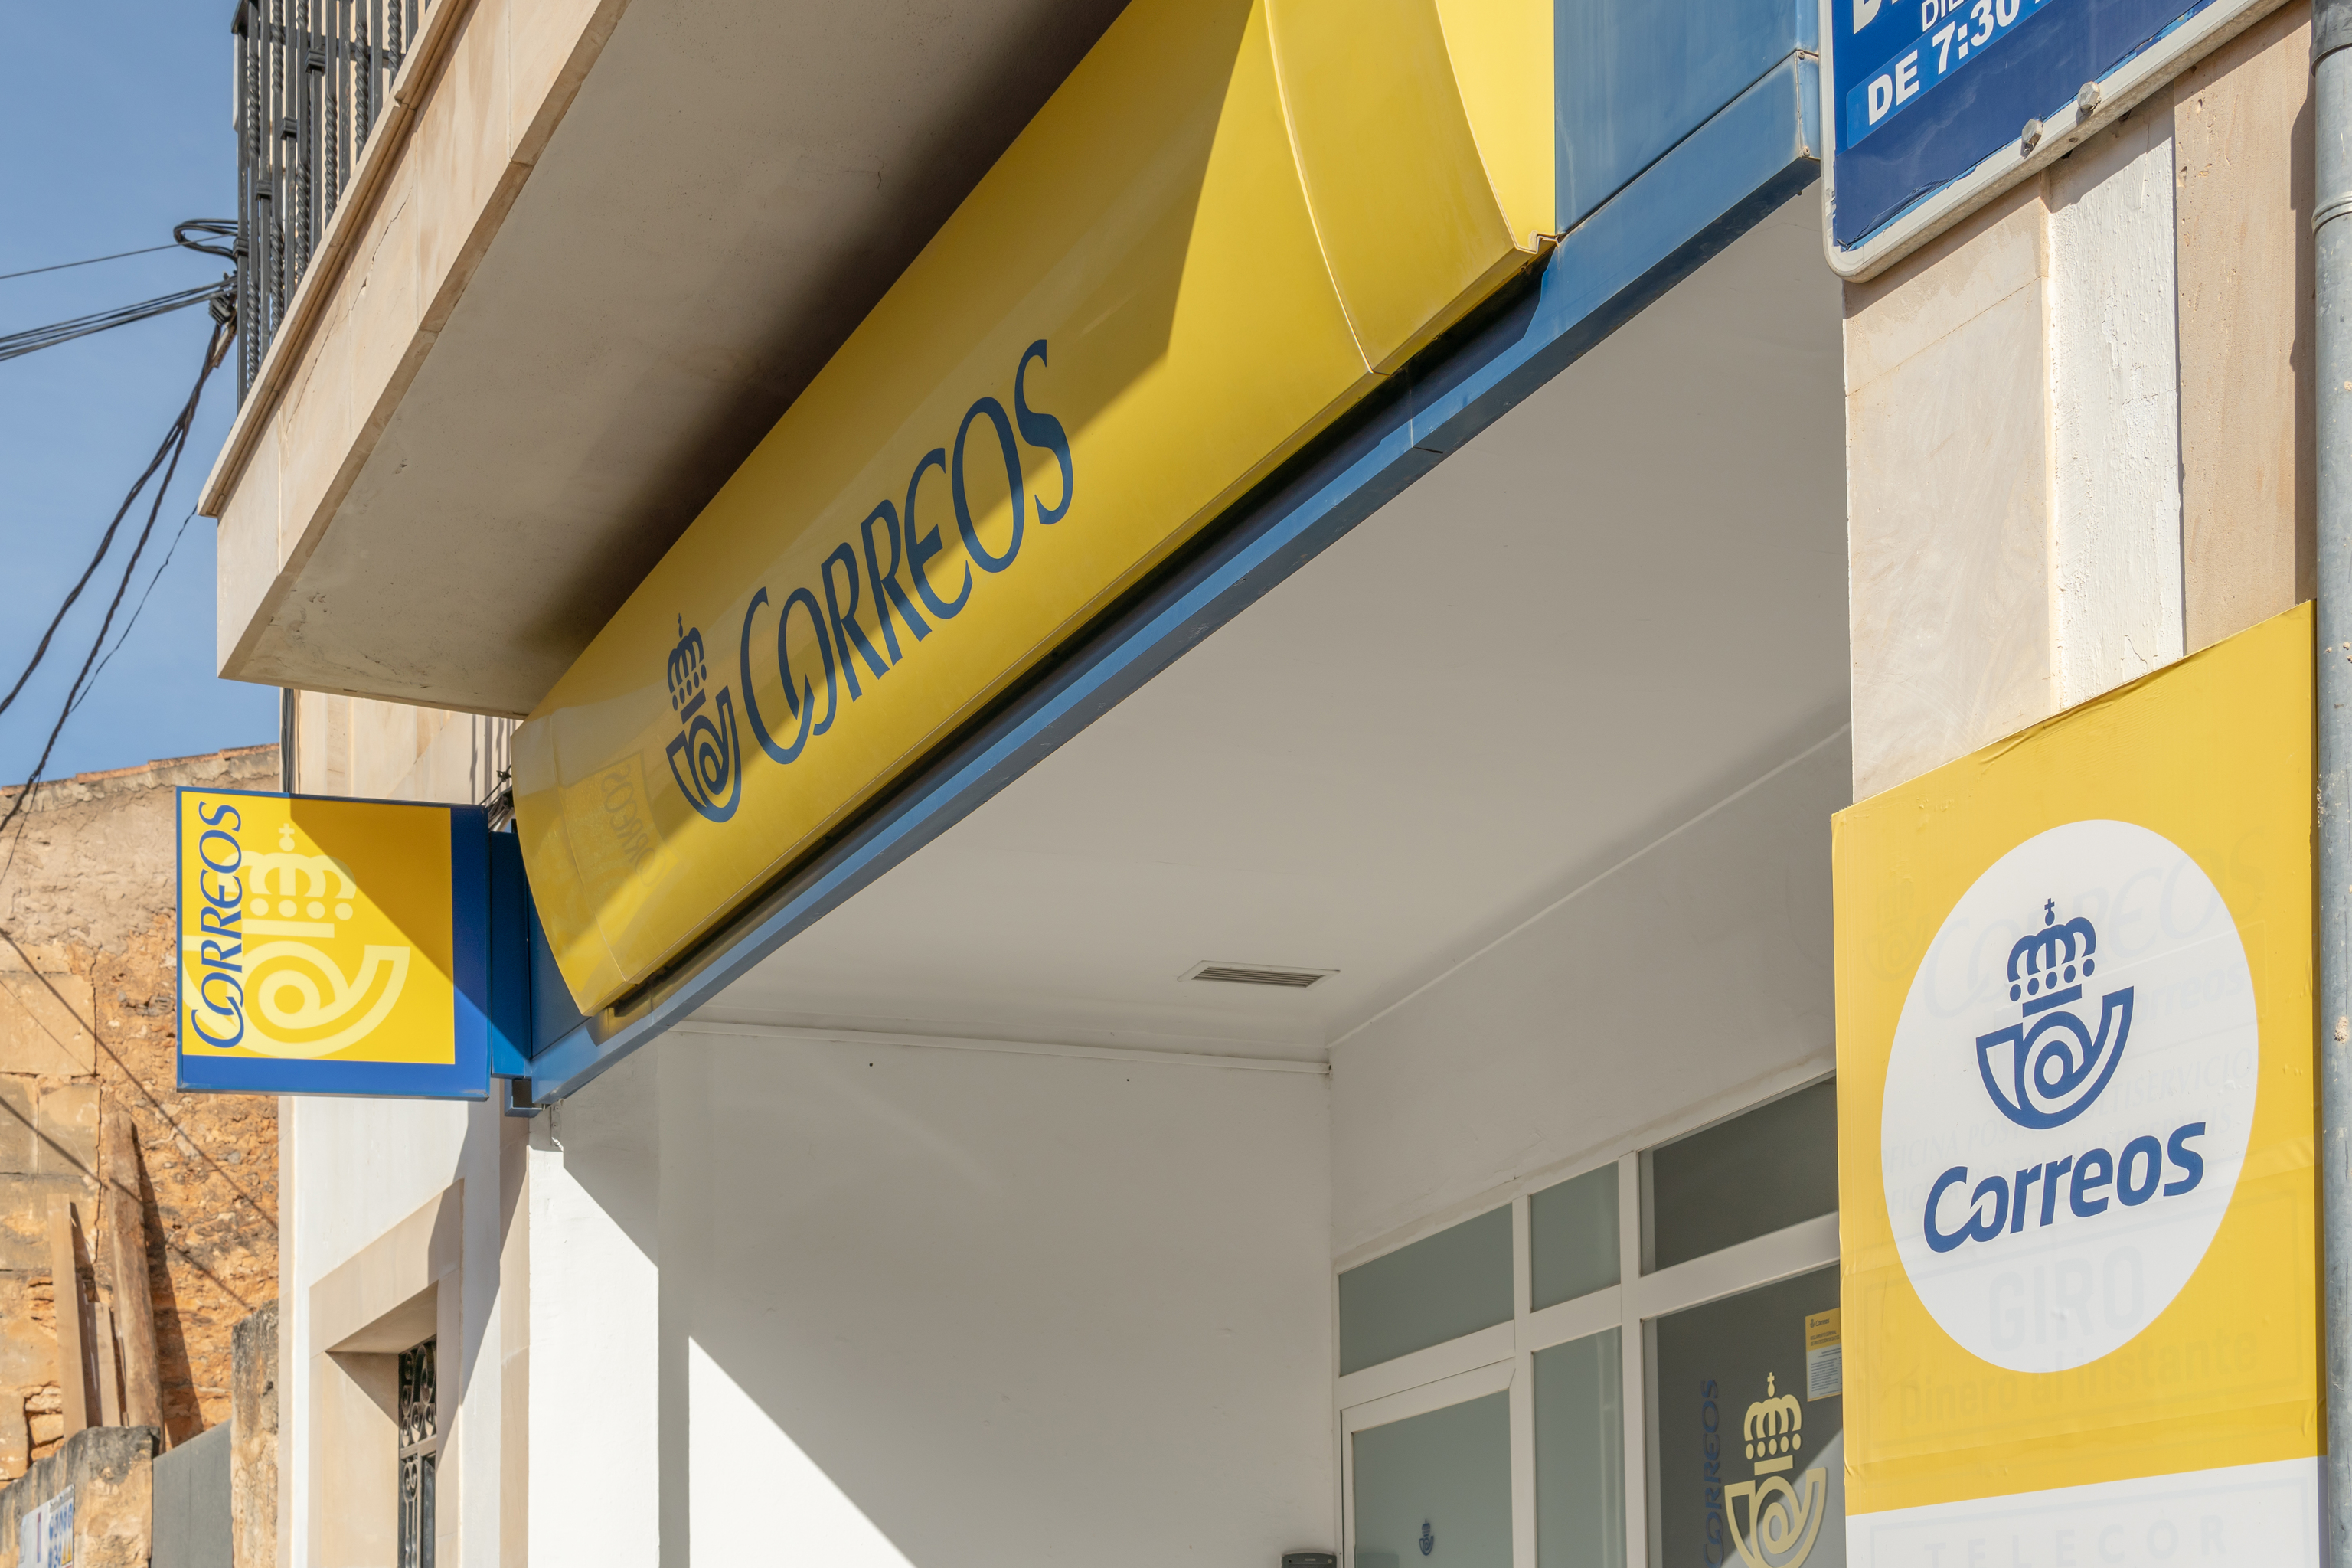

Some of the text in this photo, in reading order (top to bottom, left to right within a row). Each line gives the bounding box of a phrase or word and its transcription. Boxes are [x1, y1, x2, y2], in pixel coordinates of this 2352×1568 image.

[1868, 49, 1919, 126] DE
[1932, 0, 2020, 75] 7:30
[740, 339, 1073, 765] CORREOS
[191, 801, 244, 1048] CORREOS
[1923, 1121, 2207, 1253] Correos
[1991, 1245, 2145, 1351] GIRO
[1900, 1373, 2018, 1427] Dinero
[2074, 1326, 2259, 1398] instante
[1700, 1379, 1724, 1568] CORREOS
